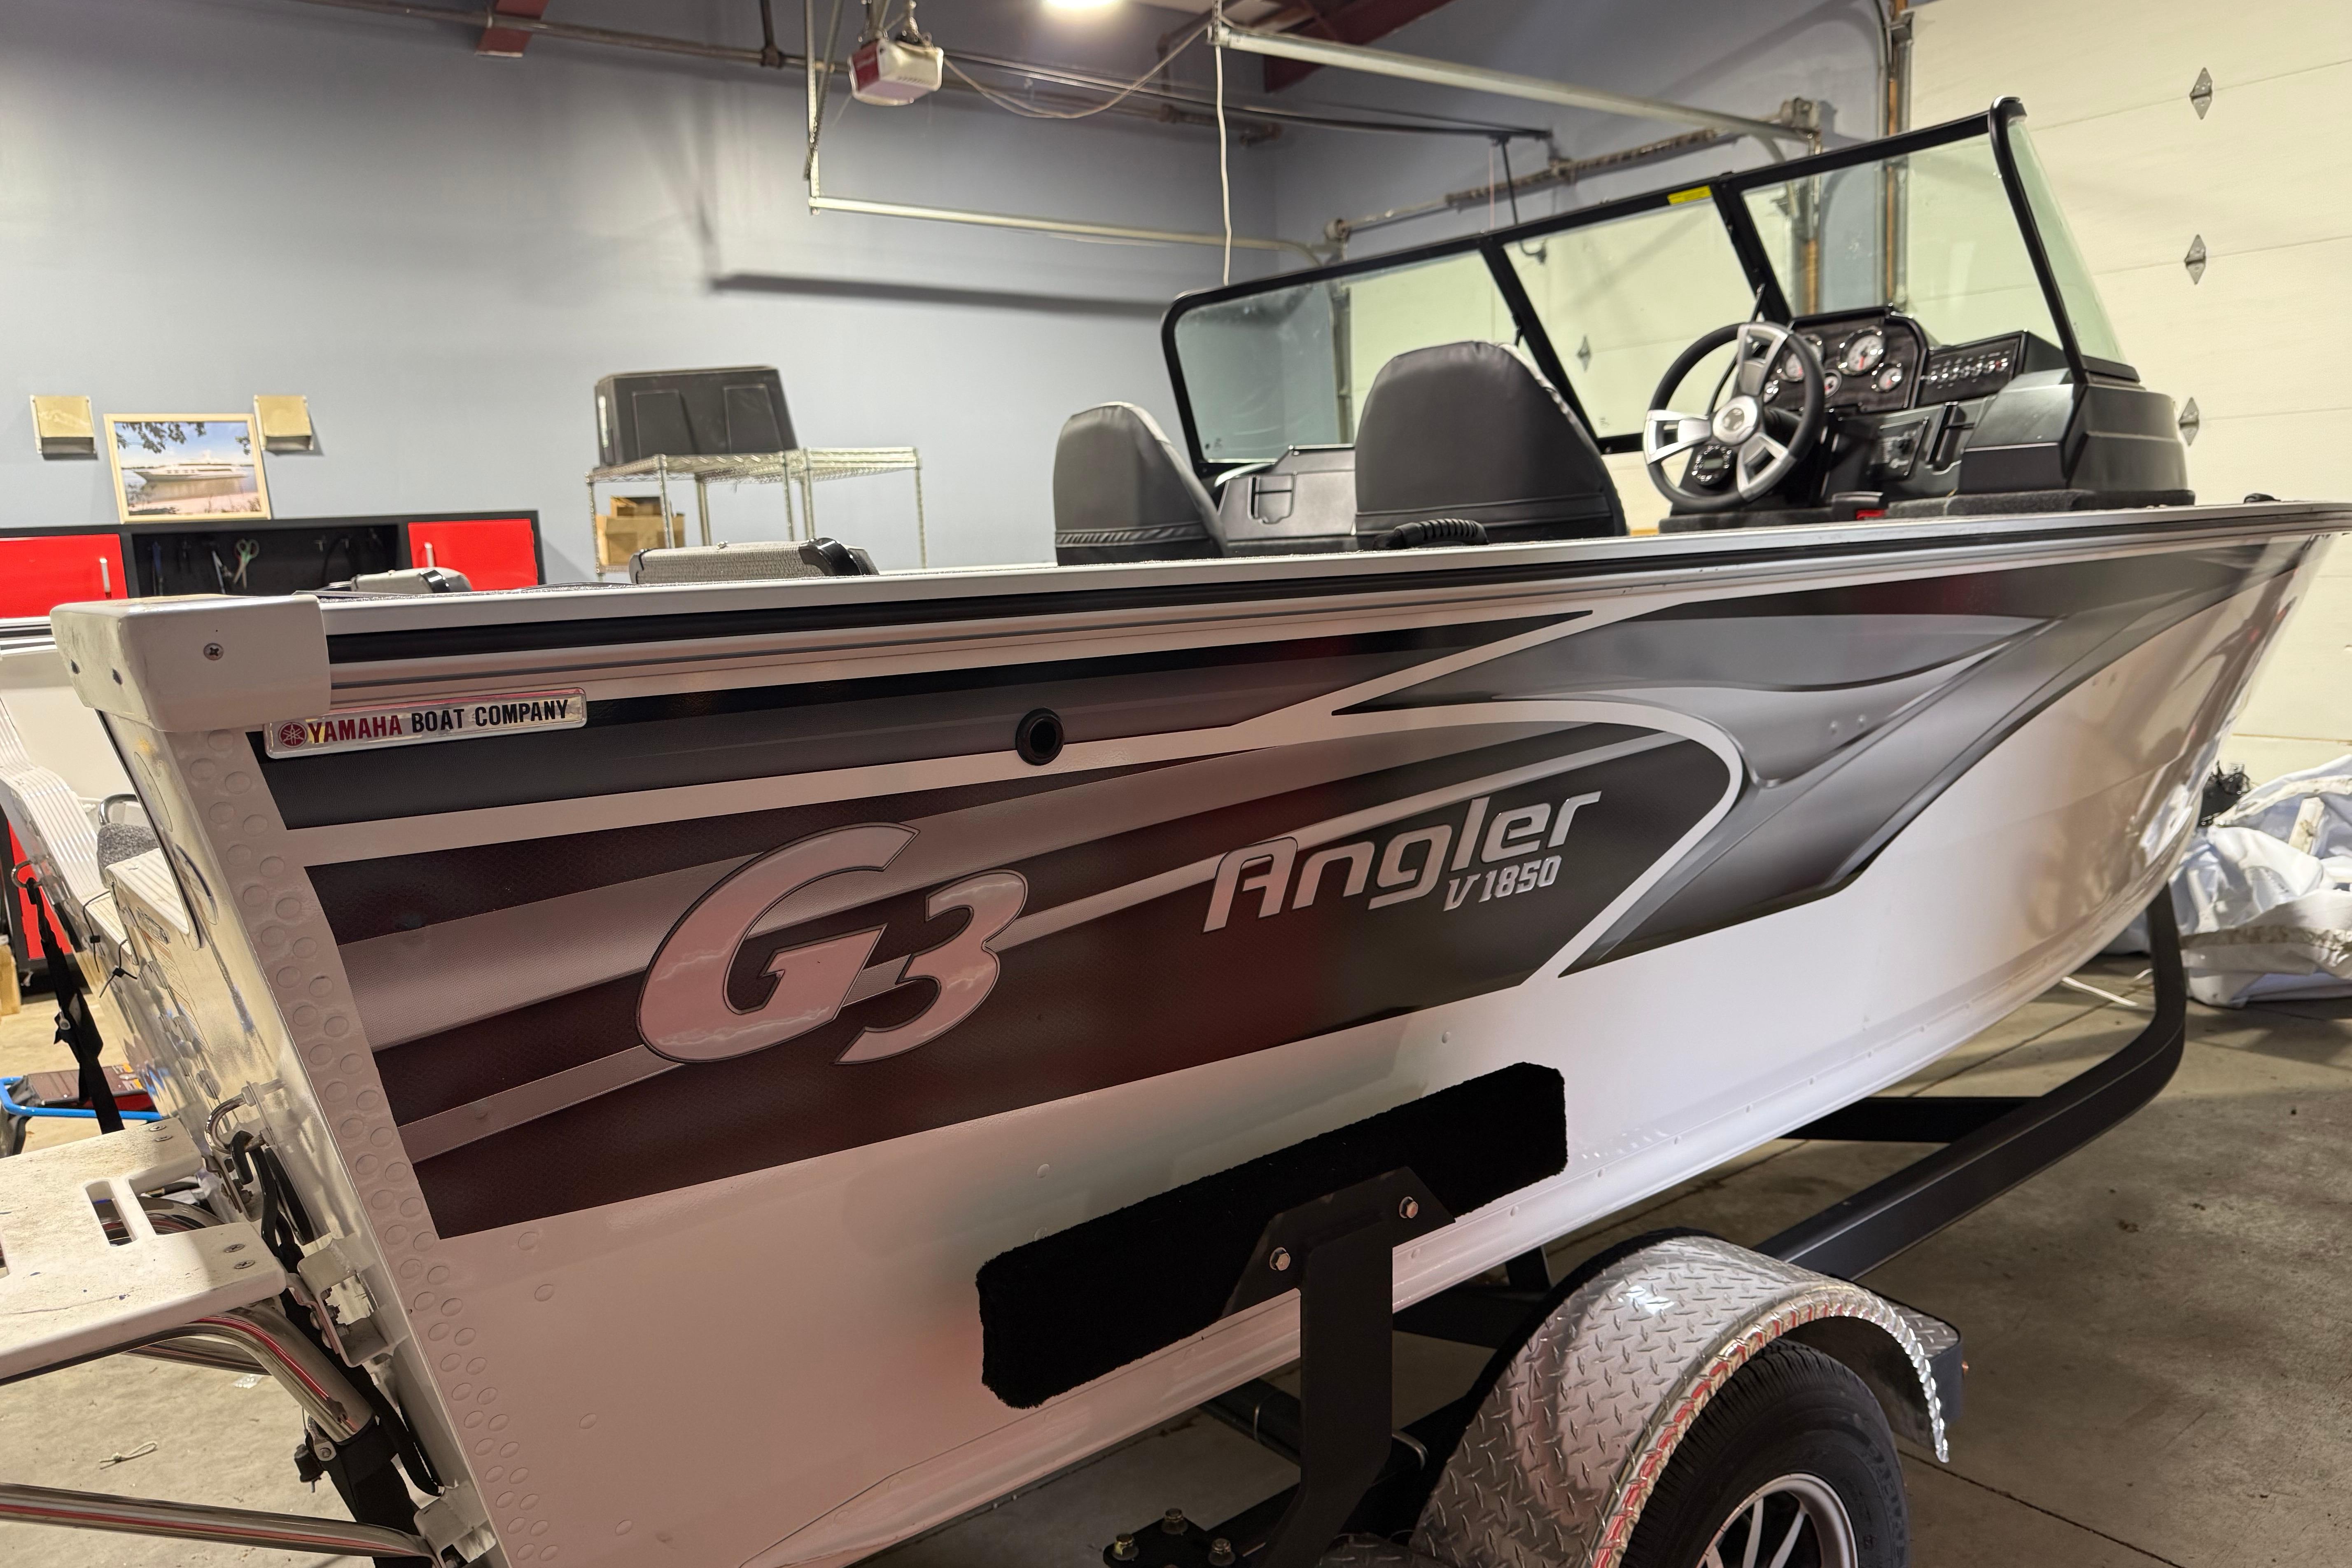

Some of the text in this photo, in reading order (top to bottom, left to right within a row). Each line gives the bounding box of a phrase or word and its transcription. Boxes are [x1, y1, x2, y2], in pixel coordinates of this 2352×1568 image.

[308, 700, 568, 743] YAMAHA BOAT COMPANY
[1202, 791, 1602, 934] Angler
[635, 822, 1029, 1065] G3
